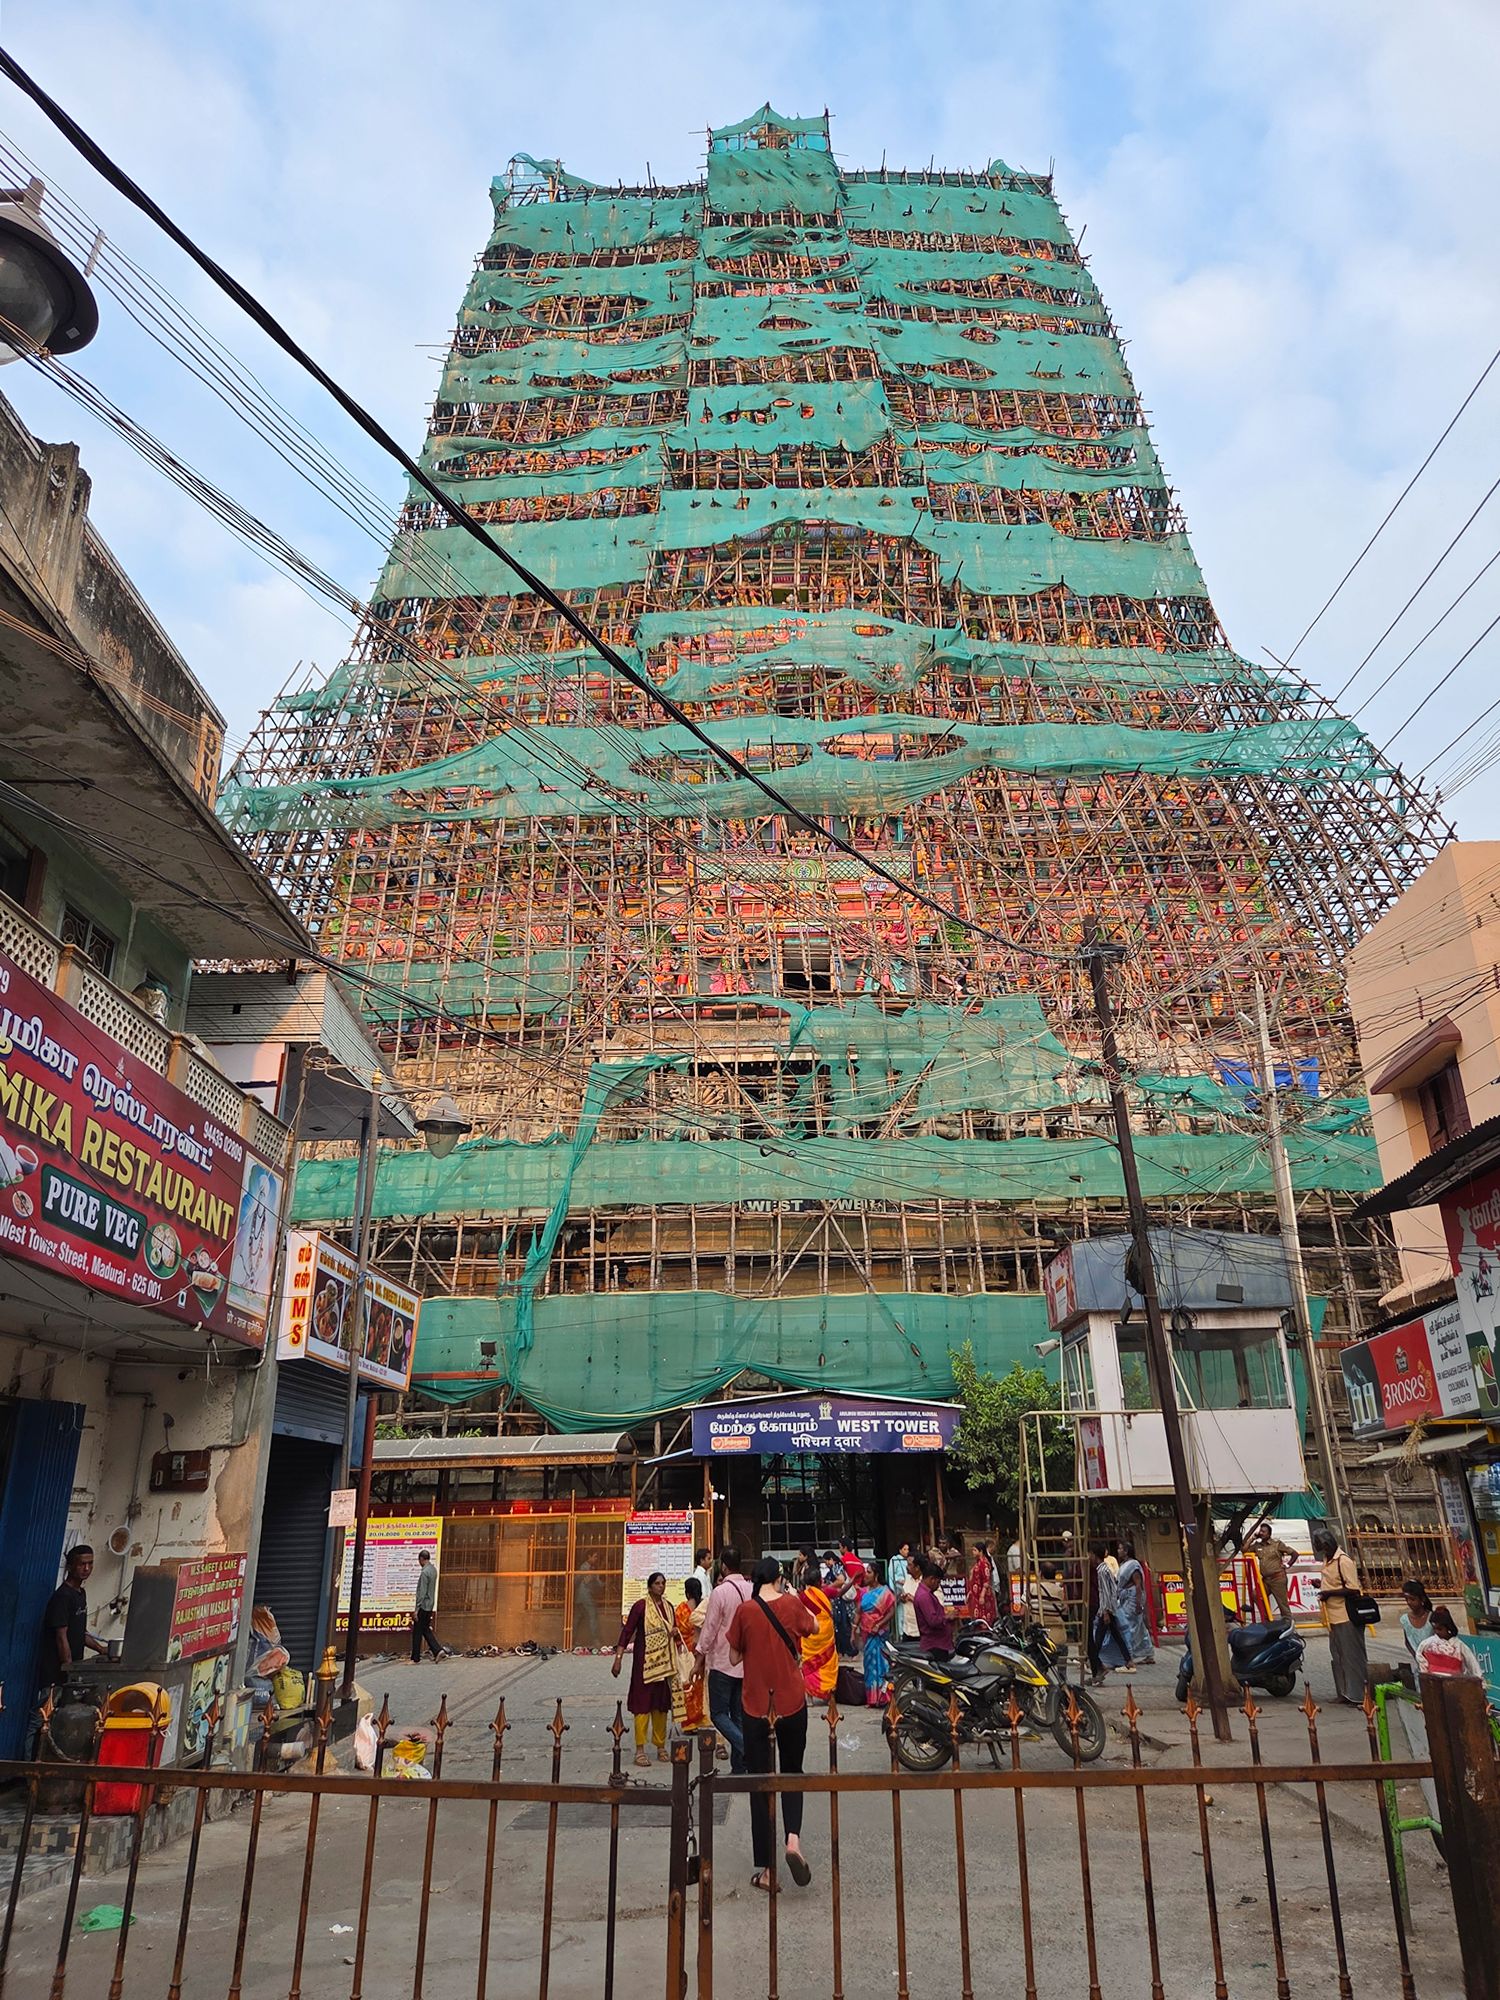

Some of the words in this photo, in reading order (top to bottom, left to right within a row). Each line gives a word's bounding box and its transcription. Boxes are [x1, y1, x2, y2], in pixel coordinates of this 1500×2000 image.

[81, 1117, 234, 1240] RESTAURANT
[45, 1175, 100, 1231] PURE
[105, 1204, 139, 1250] VEG
[0, 1215, 27, 1246] West
[58, 1241, 89, 1275] Street,
[91, 1255, 127, 1286] Madurai
[131, 1273, 147, 1295] 625
[709, 1419, 756, 1436] மேற்கு
[759, 1417, 818, 1434] கோபுரம்
[837, 1420, 880, 1433] WEST
[885, 1420, 940, 1433] TOWER
[791, 1433, 831, 1448] पश्चिम
[224, 1559, 238, 1570] CAKE
